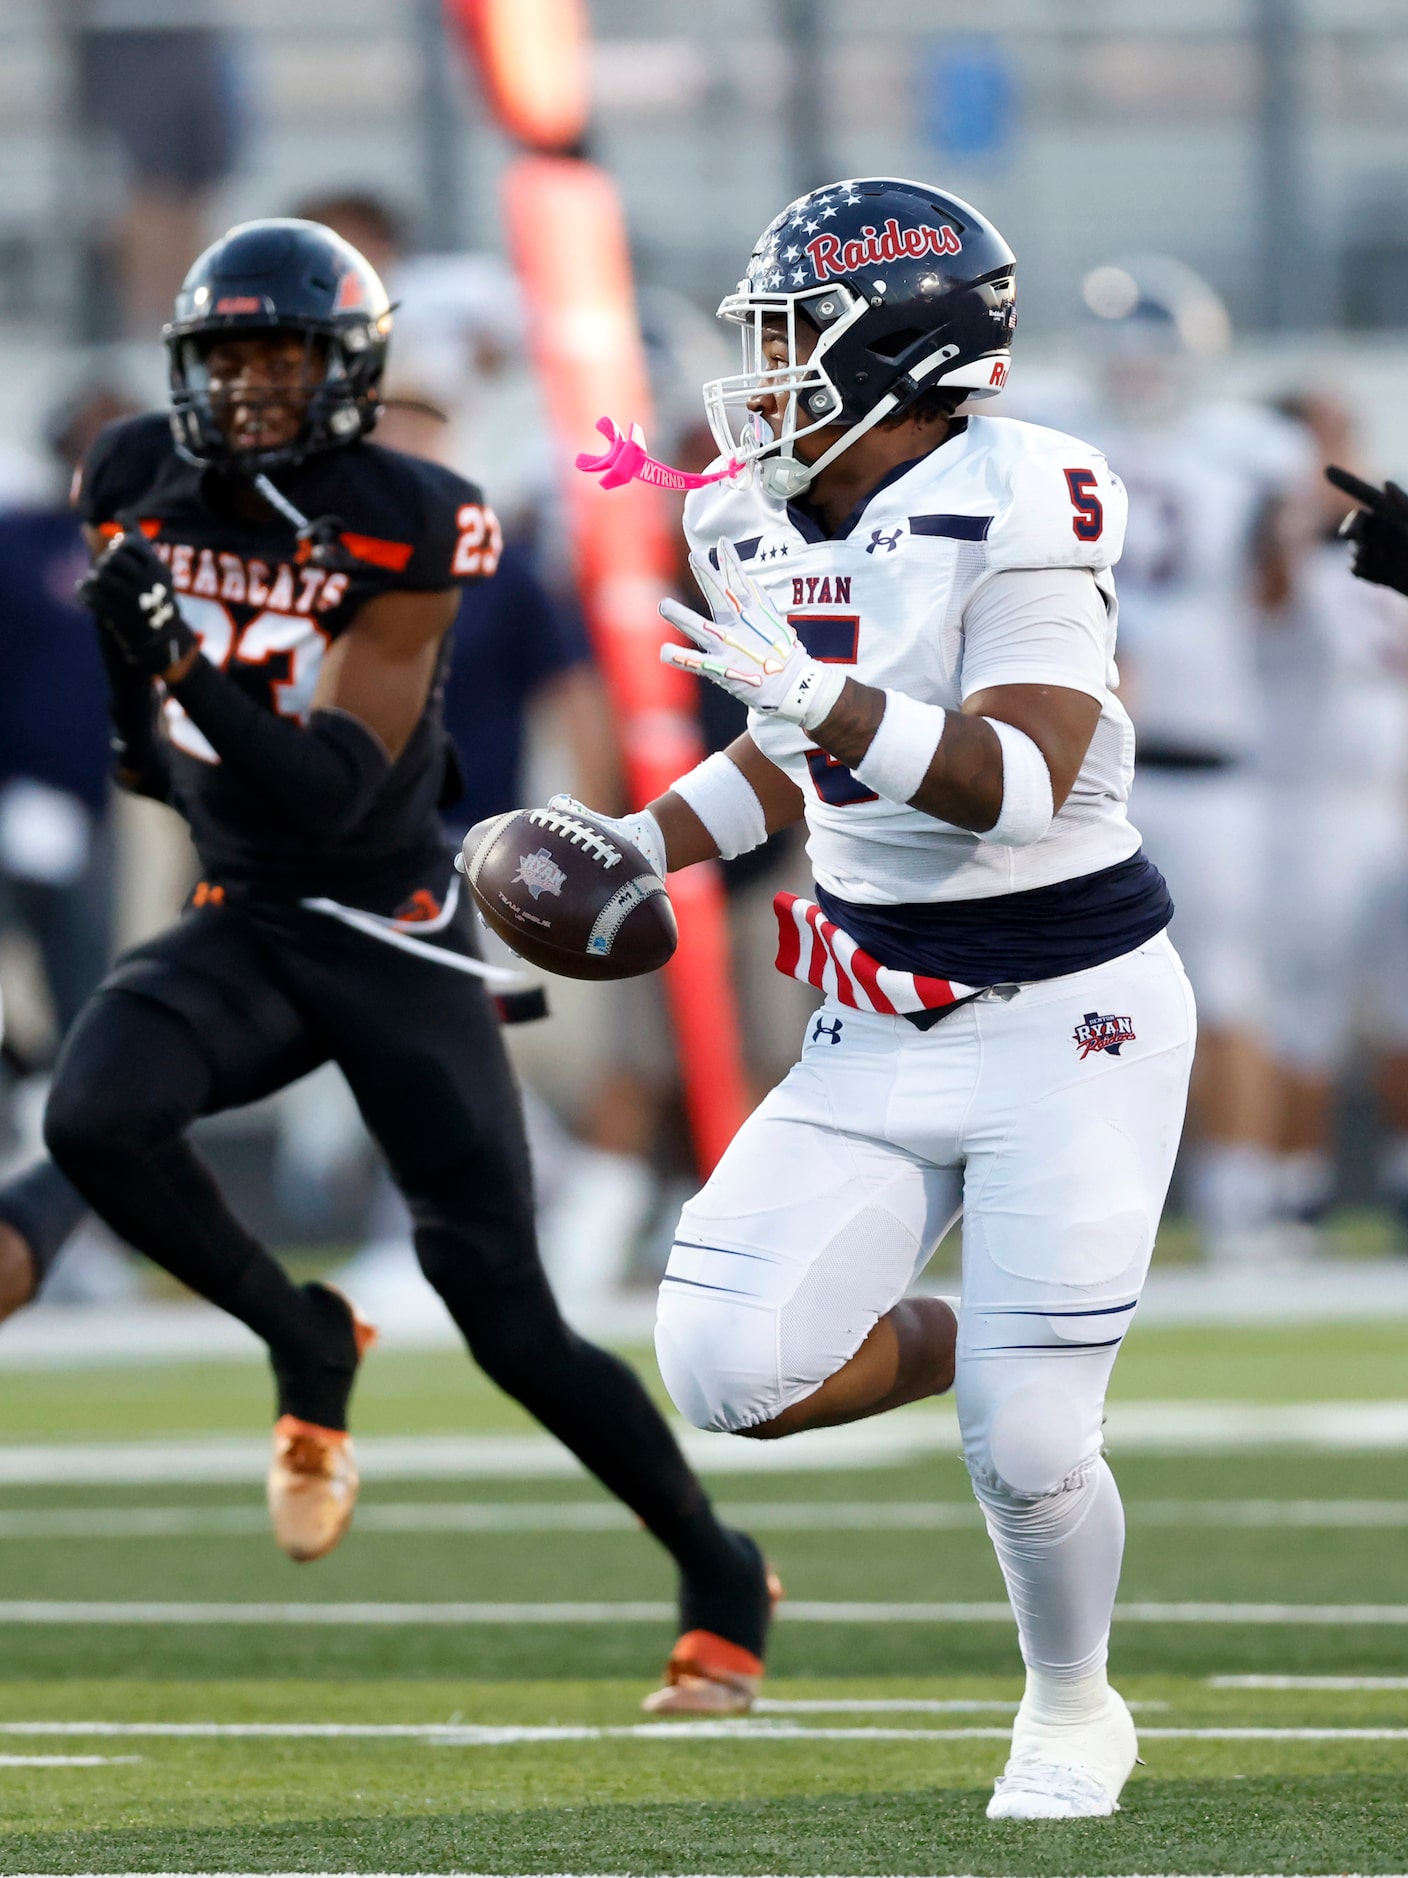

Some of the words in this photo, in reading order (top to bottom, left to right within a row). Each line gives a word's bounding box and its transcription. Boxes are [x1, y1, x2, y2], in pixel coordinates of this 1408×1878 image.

[805, 218, 962, 280] Raiders
[640, 460, 686, 489] NXTRND
[1062, 468, 1104, 542] 5
[450, 503, 503, 578] 23
[154, 541, 351, 614] EARCATS
[792, 576, 852, 605] RYAN
[1076, 1018, 1131, 1043] RYAN
